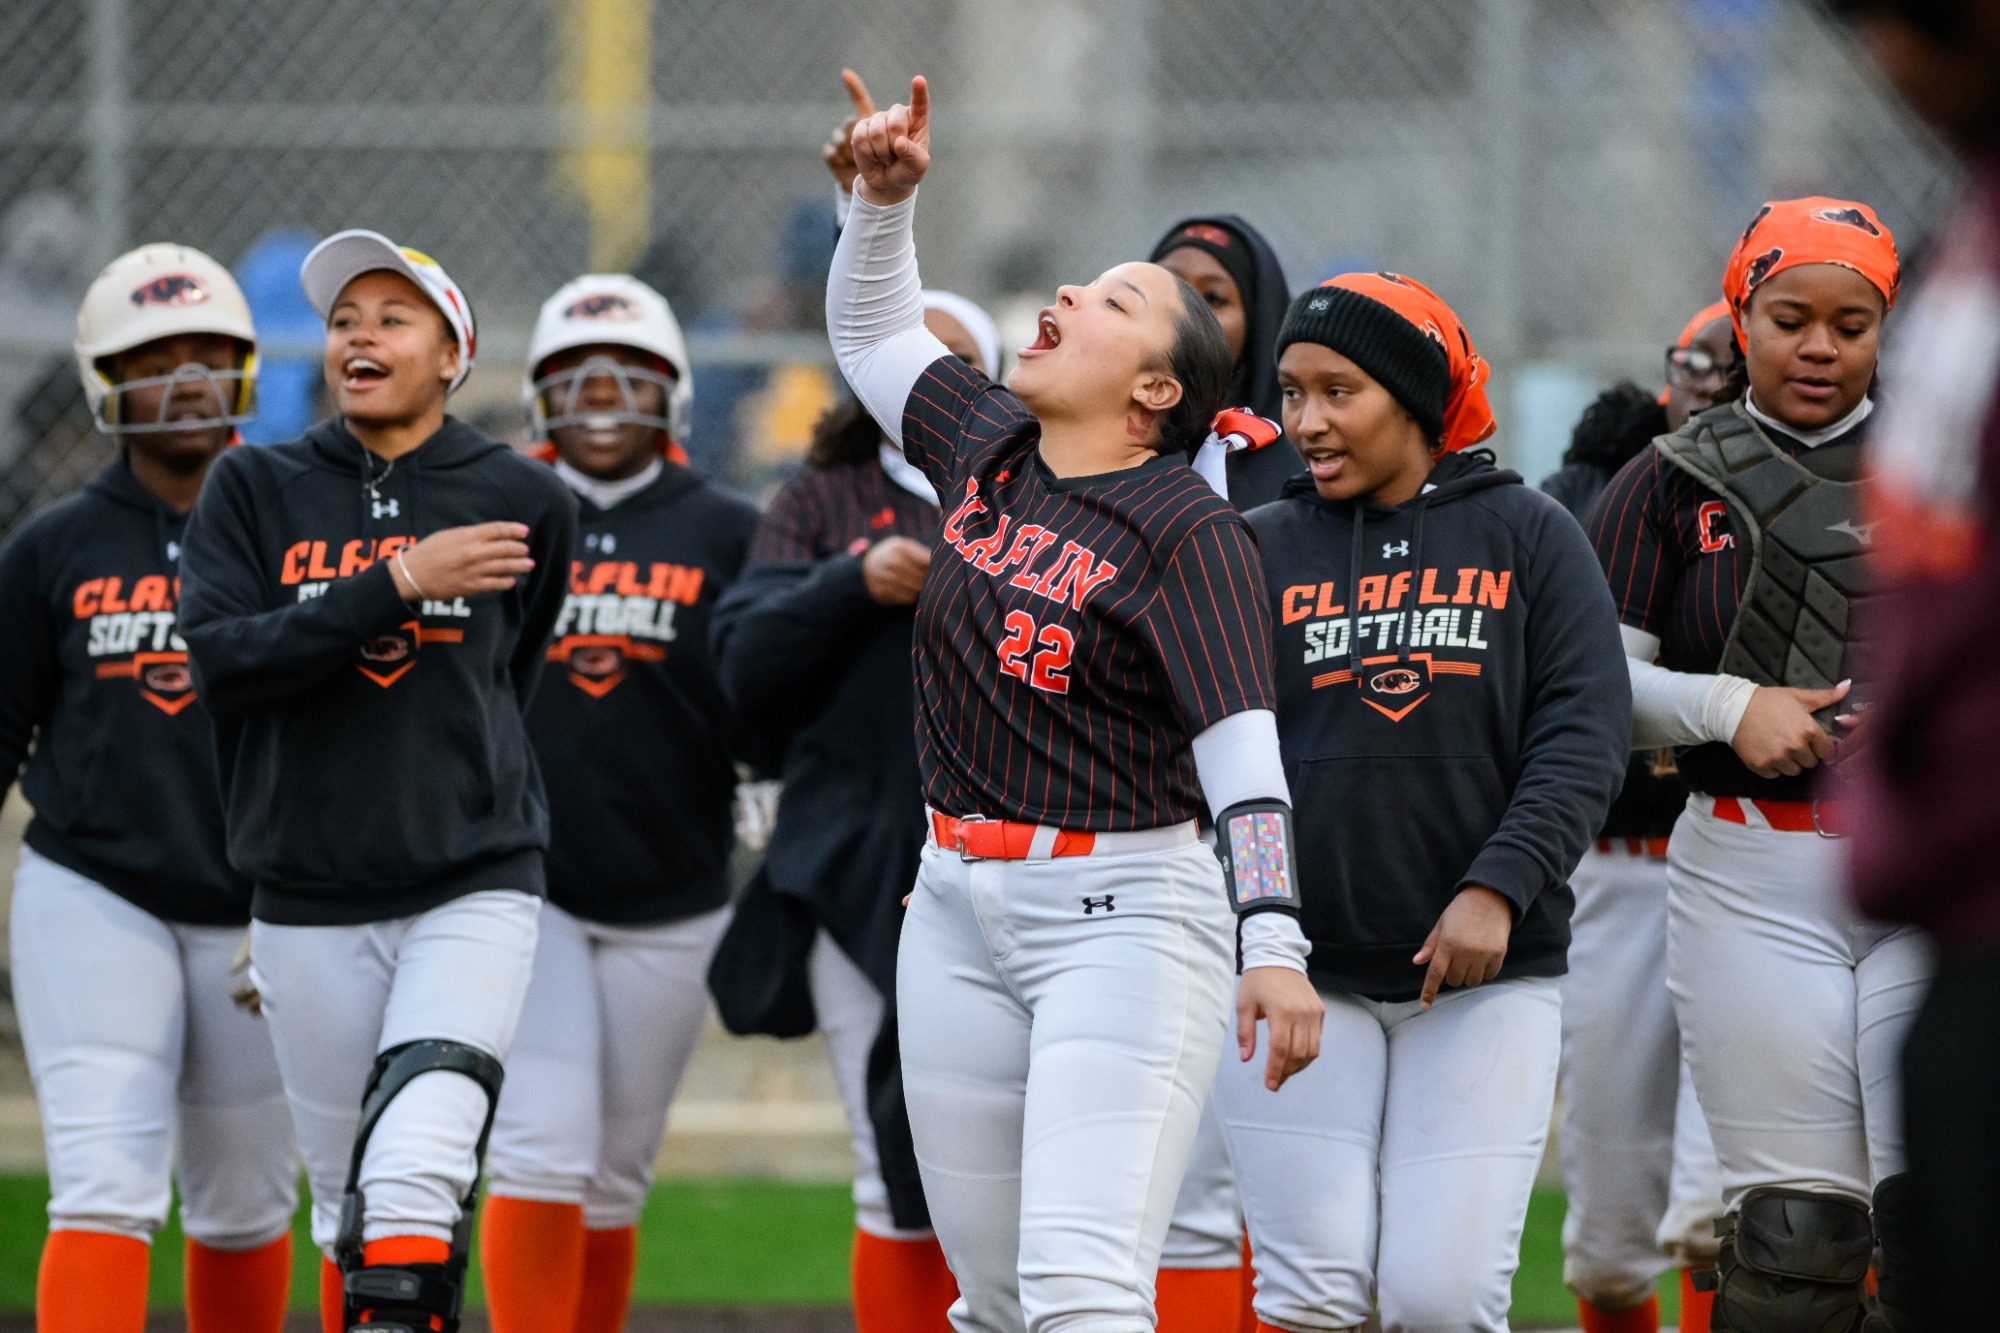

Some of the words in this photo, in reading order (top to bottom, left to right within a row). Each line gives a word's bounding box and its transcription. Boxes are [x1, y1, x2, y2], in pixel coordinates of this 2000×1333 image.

[1282, 568, 1511, 625] CLAFLIN
[997, 609, 1075, 694] 22
[1304, 608, 1488, 664] SOFTBALL
